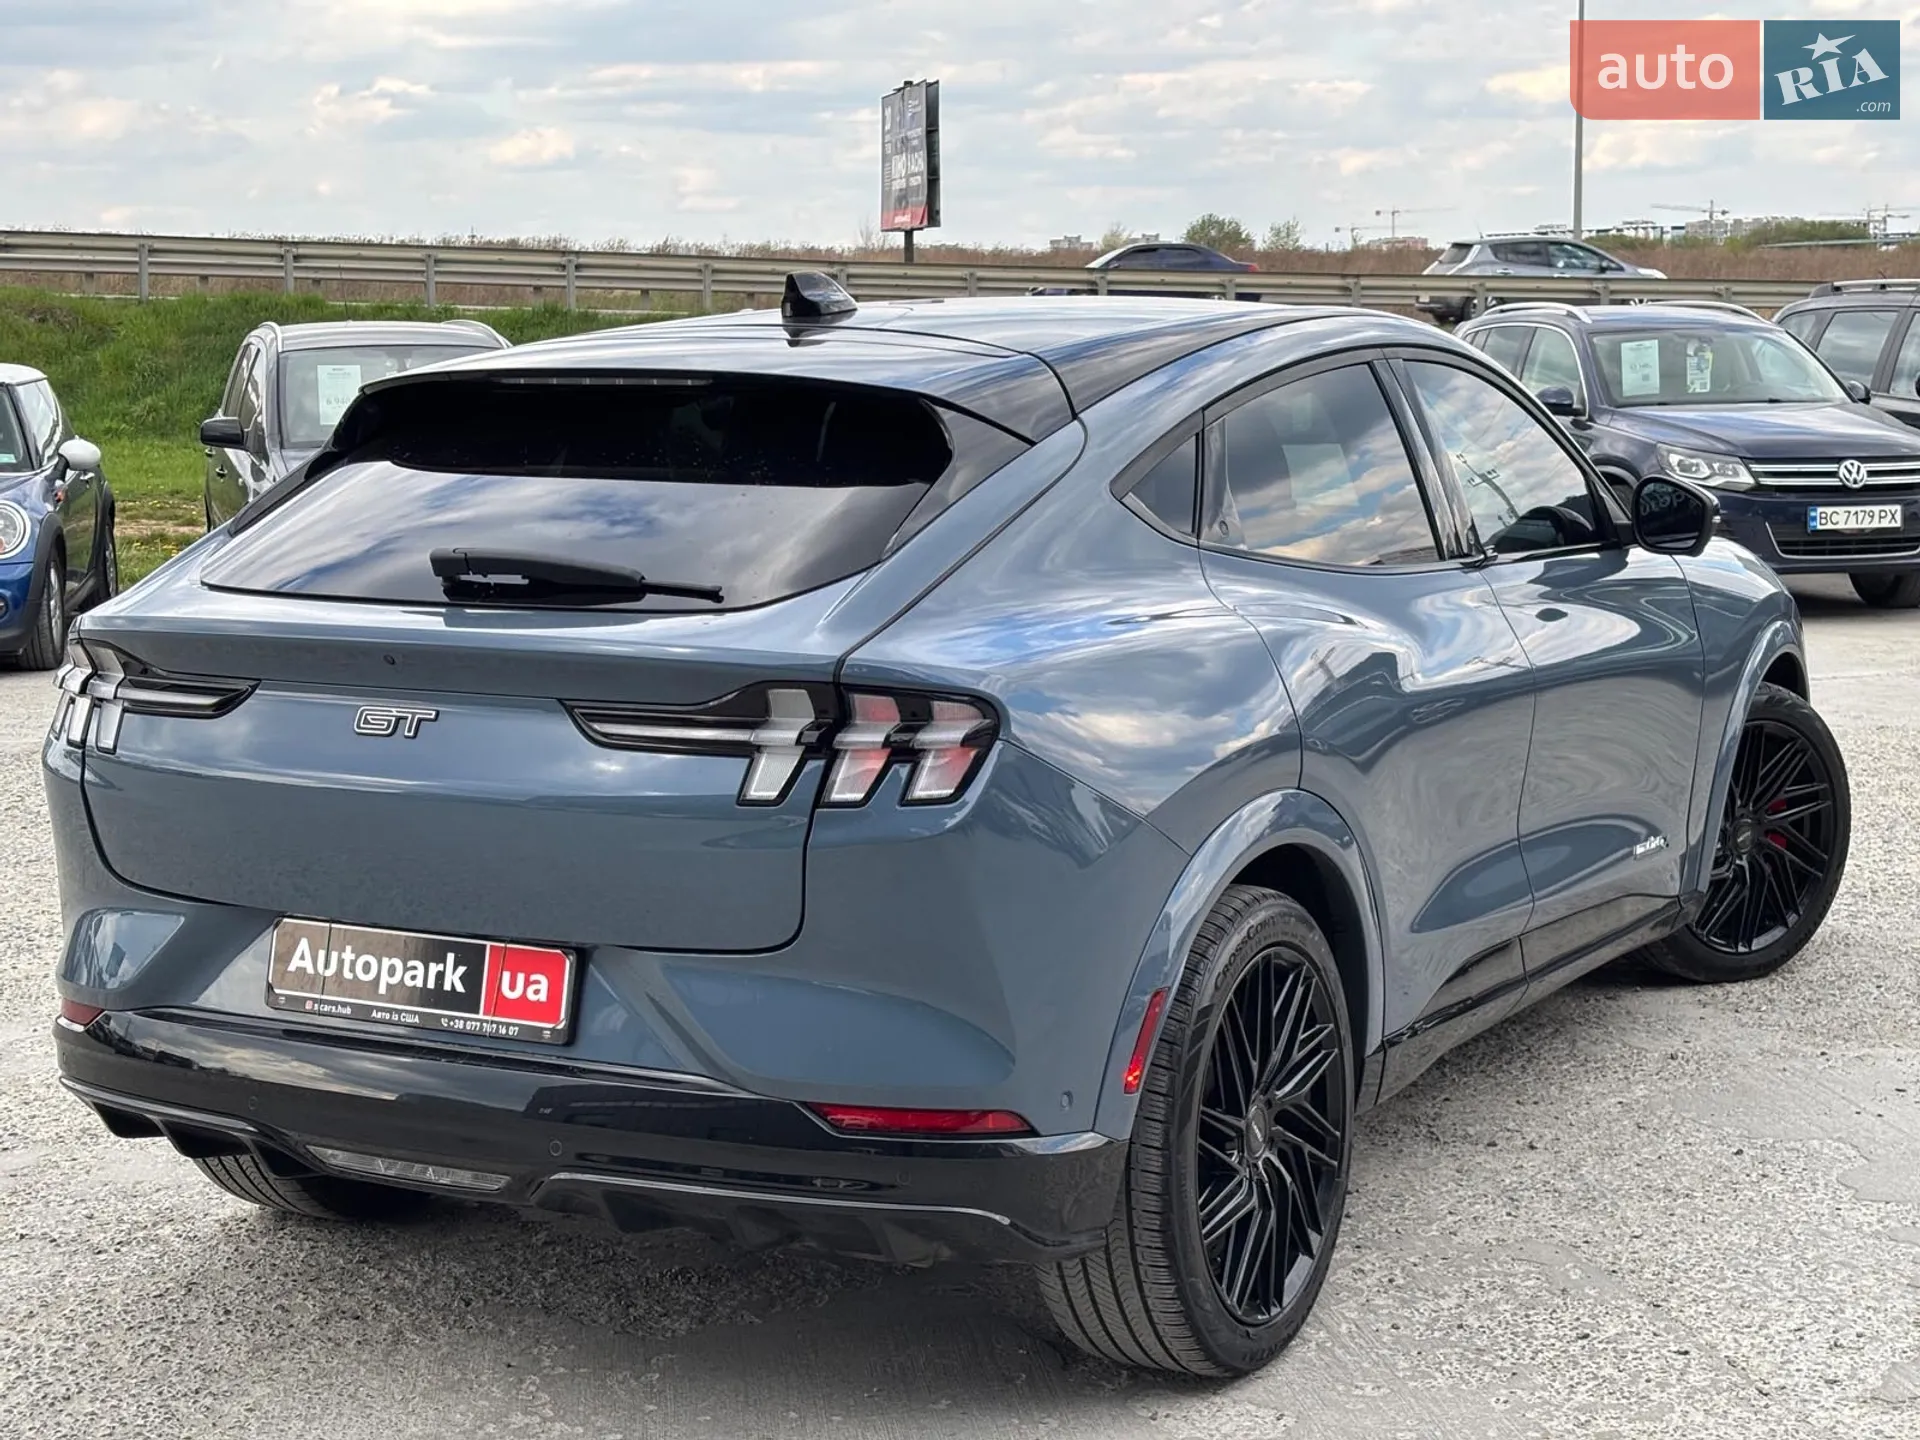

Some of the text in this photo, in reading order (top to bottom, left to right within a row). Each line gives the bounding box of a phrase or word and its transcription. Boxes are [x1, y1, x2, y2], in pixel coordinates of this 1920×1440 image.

[1819, 508, 1898, 526] BC 7179 PX
[354, 706, 438, 738] GT
[287, 937, 548, 1002] Autopark ua
